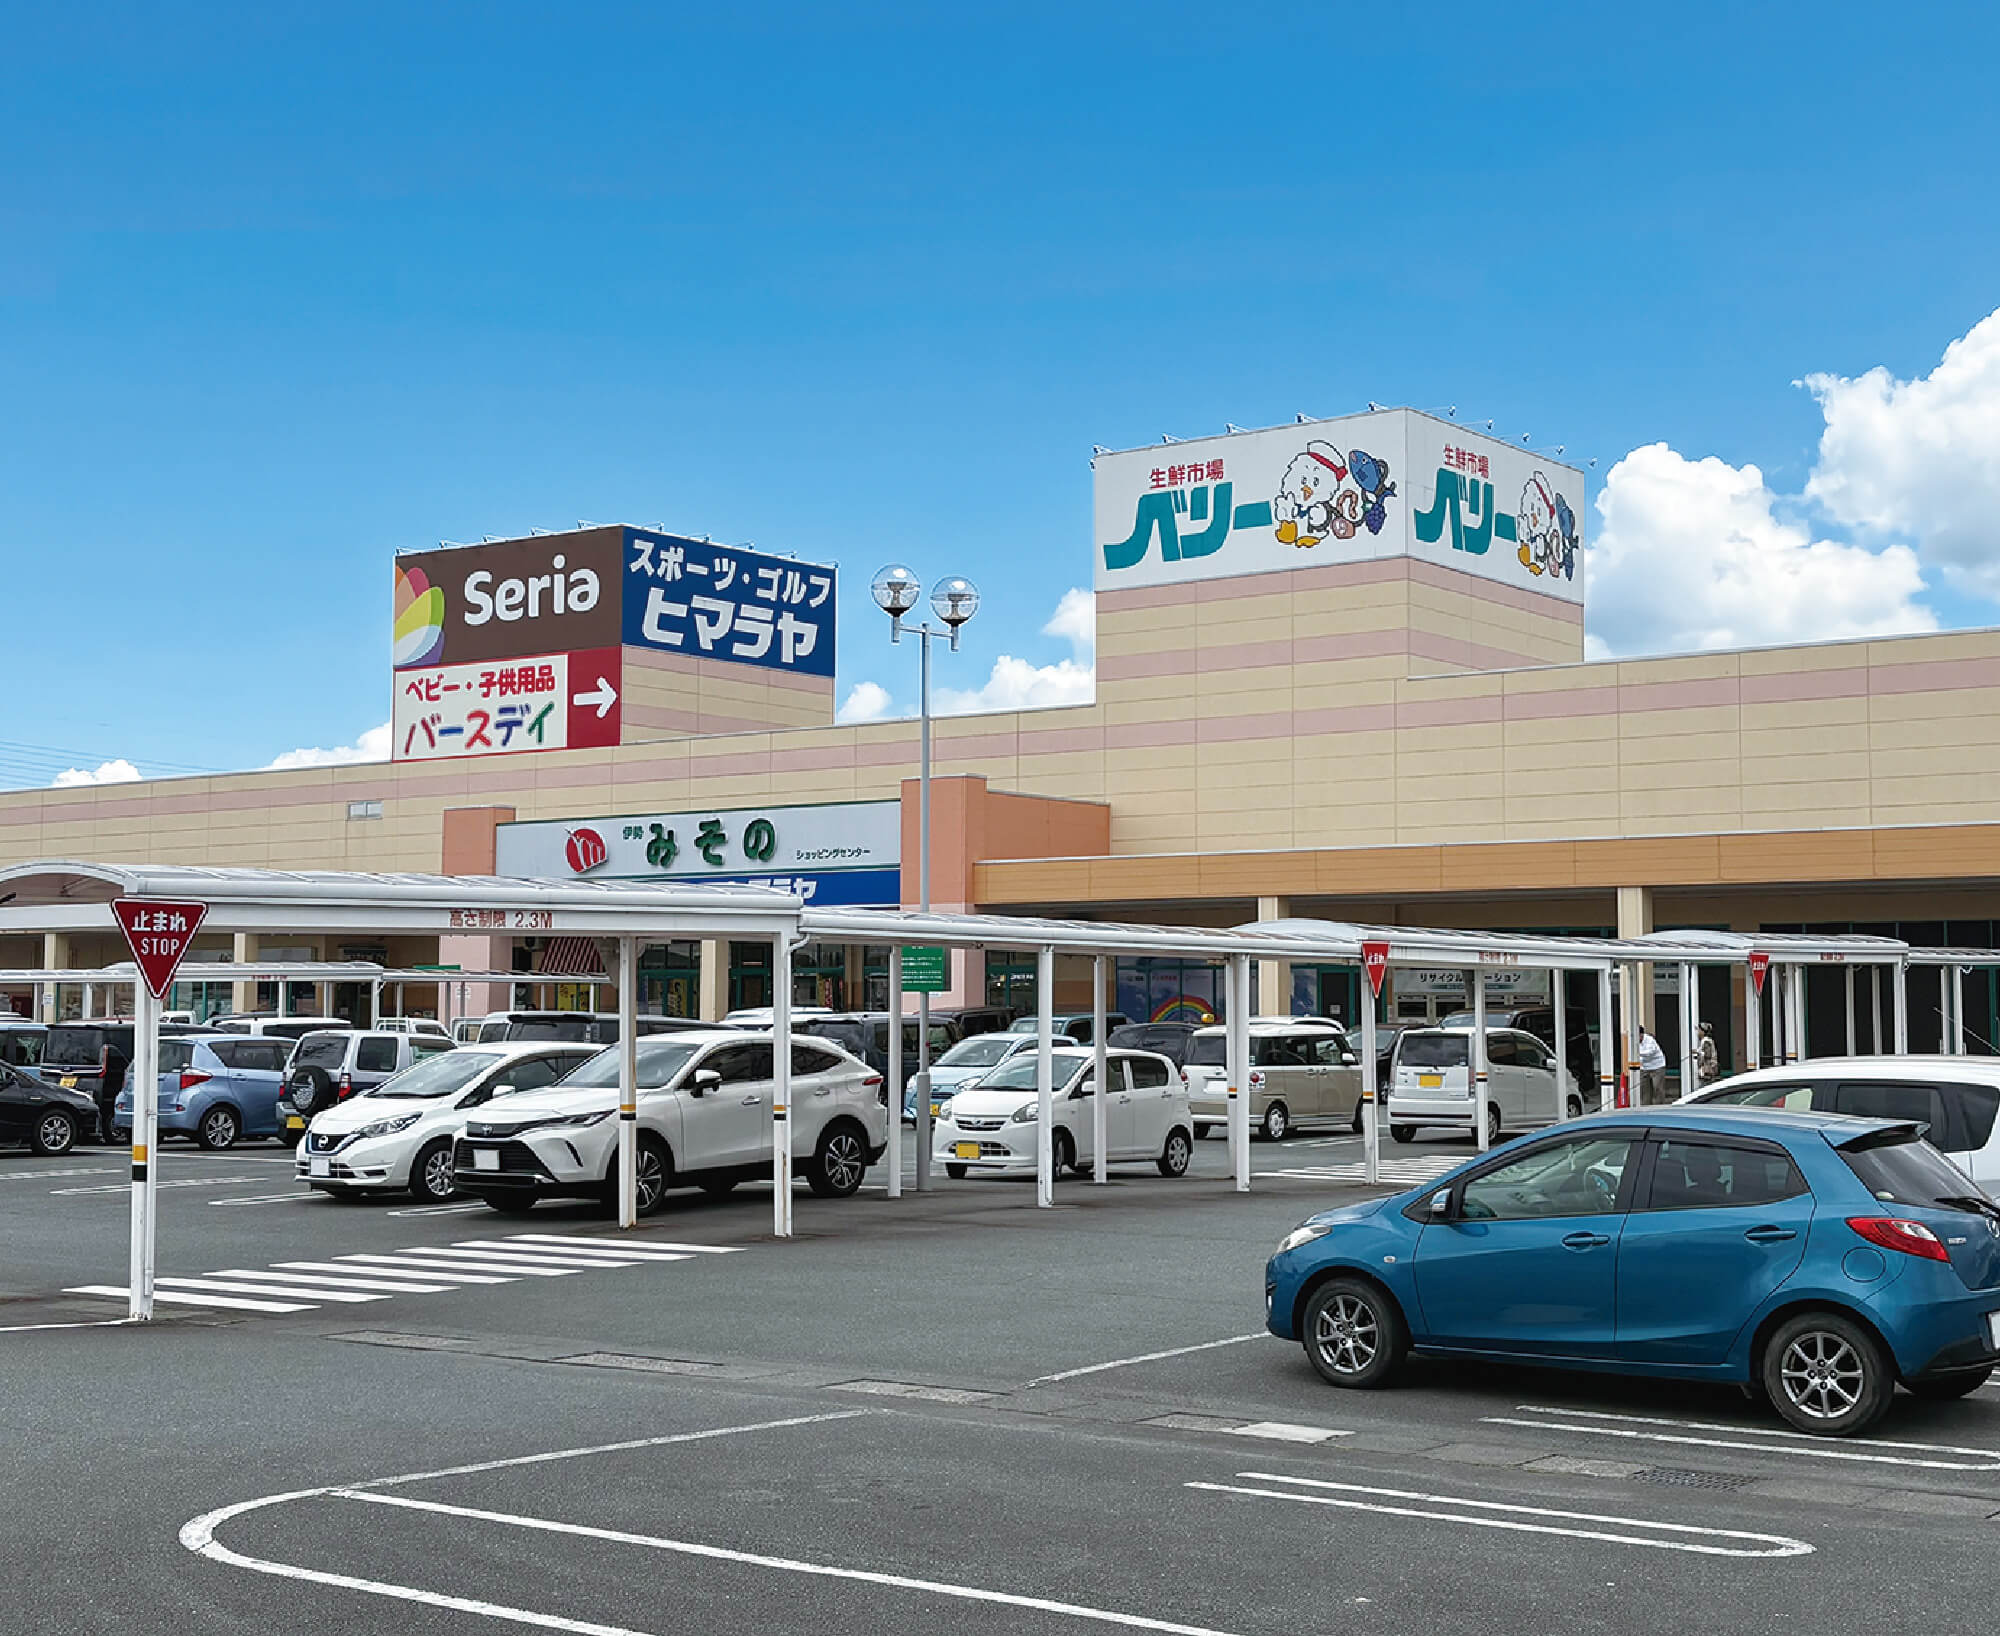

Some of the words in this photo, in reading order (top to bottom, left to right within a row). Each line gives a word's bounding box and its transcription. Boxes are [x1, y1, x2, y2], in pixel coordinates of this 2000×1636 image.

[1150, 458, 1224, 489] 生鮮市場
[1443, 443, 1489, 479] 生鮮市場
[464, 554, 600, 626] Seria
[630, 538, 831, 608] スポーツ・ゴルフ
[642, 587, 818, 663] ヒマラヤ
[405, 664, 555, 702] ベビー・子供用品
[404, 701, 554, 755] バースデイ
[646, 817, 777, 868] みその
[131, 910, 188, 933] 止まれ
[515, 911, 553, 928] 2.3M
[140, 936, 180, 956] STOP
[1420, 973, 1521, 982] リサイクルーション
